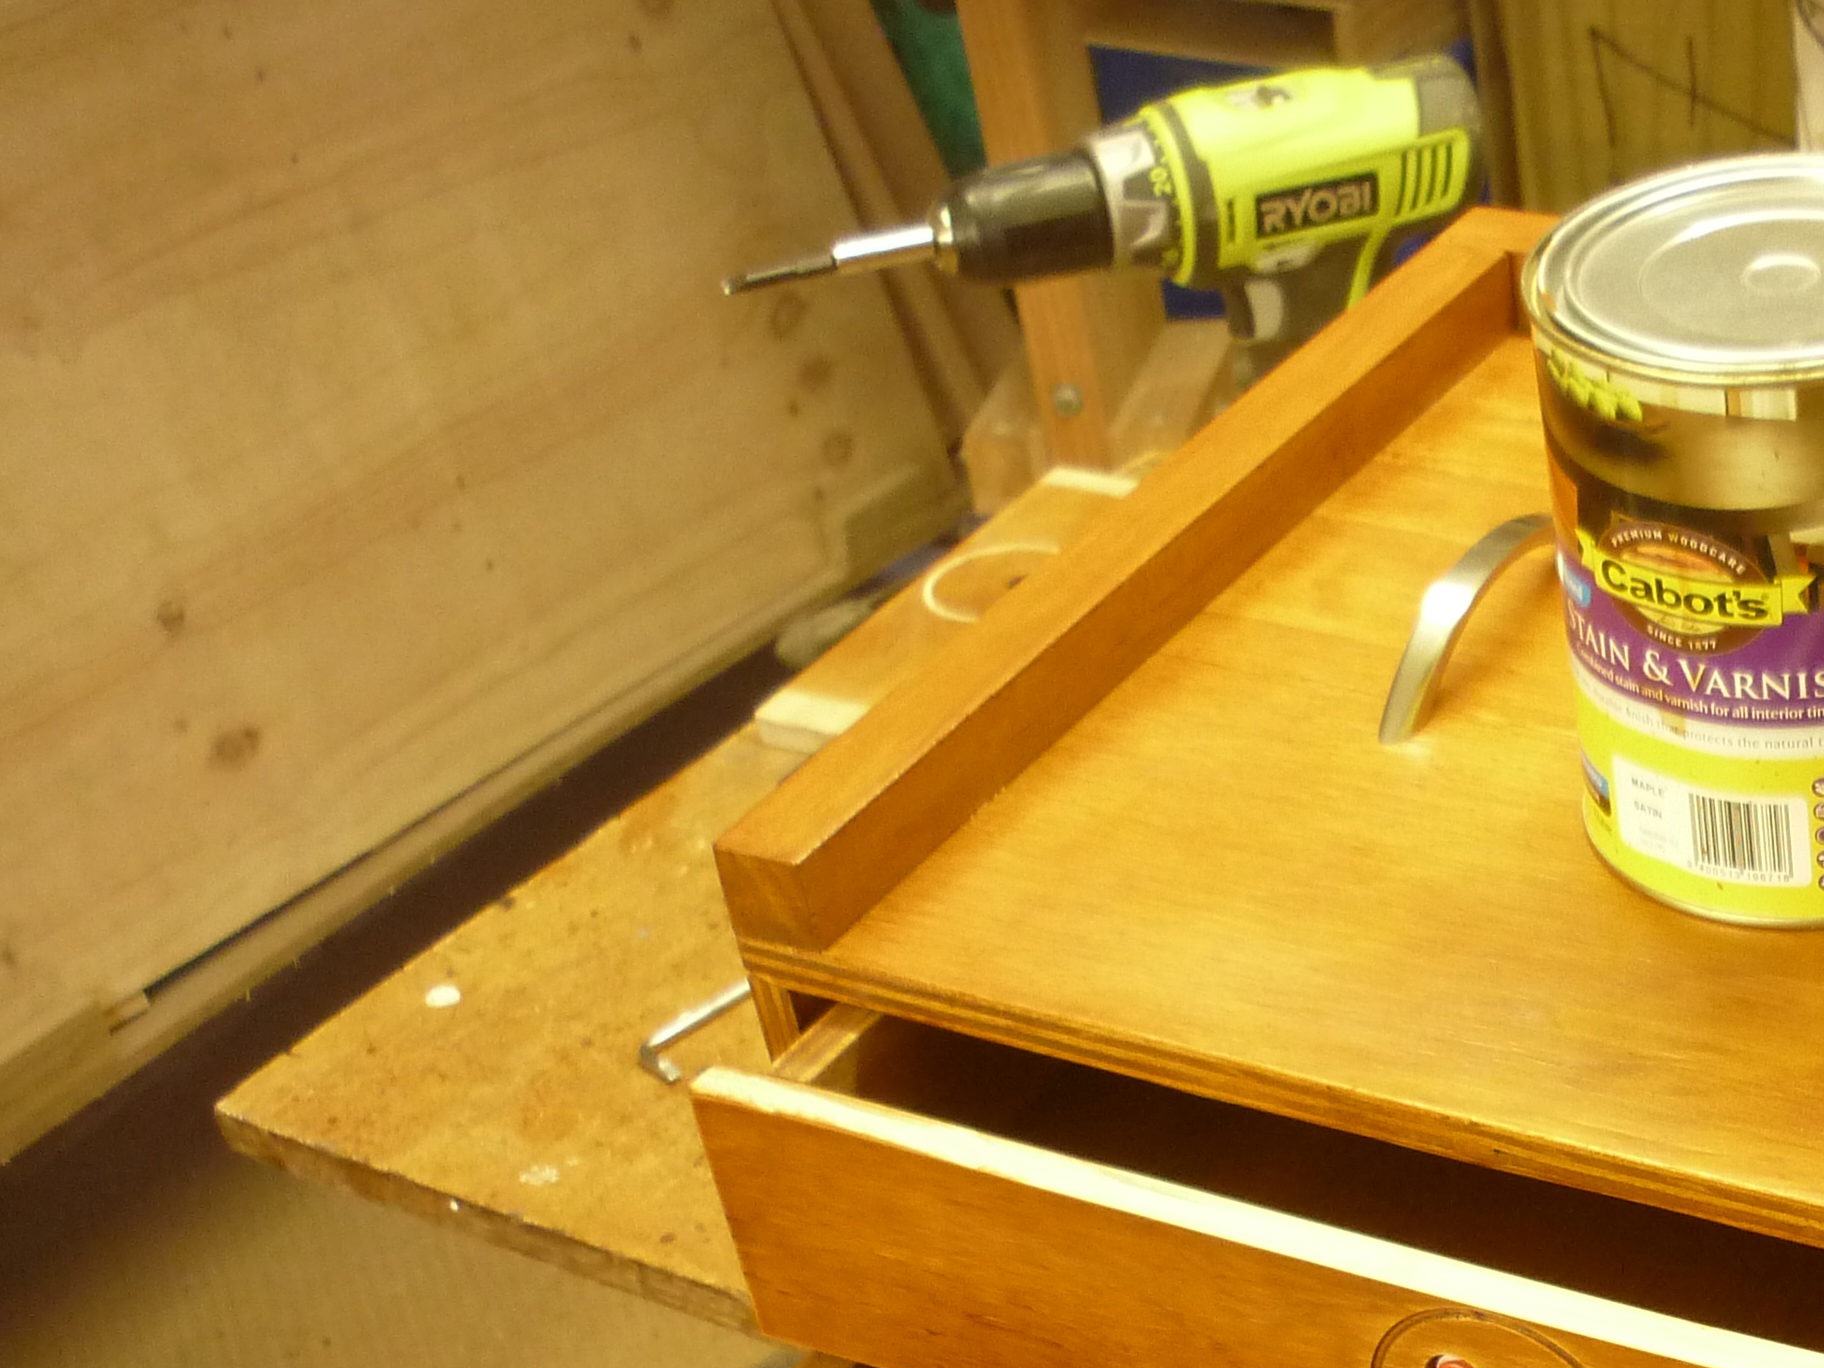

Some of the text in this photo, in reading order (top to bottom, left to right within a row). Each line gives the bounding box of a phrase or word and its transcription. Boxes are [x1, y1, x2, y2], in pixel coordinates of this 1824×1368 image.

[1260, 181, 1370, 233] RYOBI
[1611, 529, 1746, 575] PREMIUM WOODCARE
[1601, 559, 1769, 620] Cabot's
[1567, 599, 1632, 672] STAIN
[1643, 649, 1674, 686] &
[1647, 625, 1717, 652] SINCE 1877
[1615, 674, 1640, 695] stain
[1641, 686, 1663, 702] and
[1664, 693, 1709, 716] varnish
[1710, 702, 1730, 717] for
[1732, 705, 1748, 719] all
[1751, 705, 1805, 721] interior
[1681, 727, 1734, 748] protects
[1737, 735, 1760, 750] the
[1764, 735, 1815, 751] natural
[1631, 777, 1665, 799] MAPLE
[1633, 800, 1662, 819] SATIN
